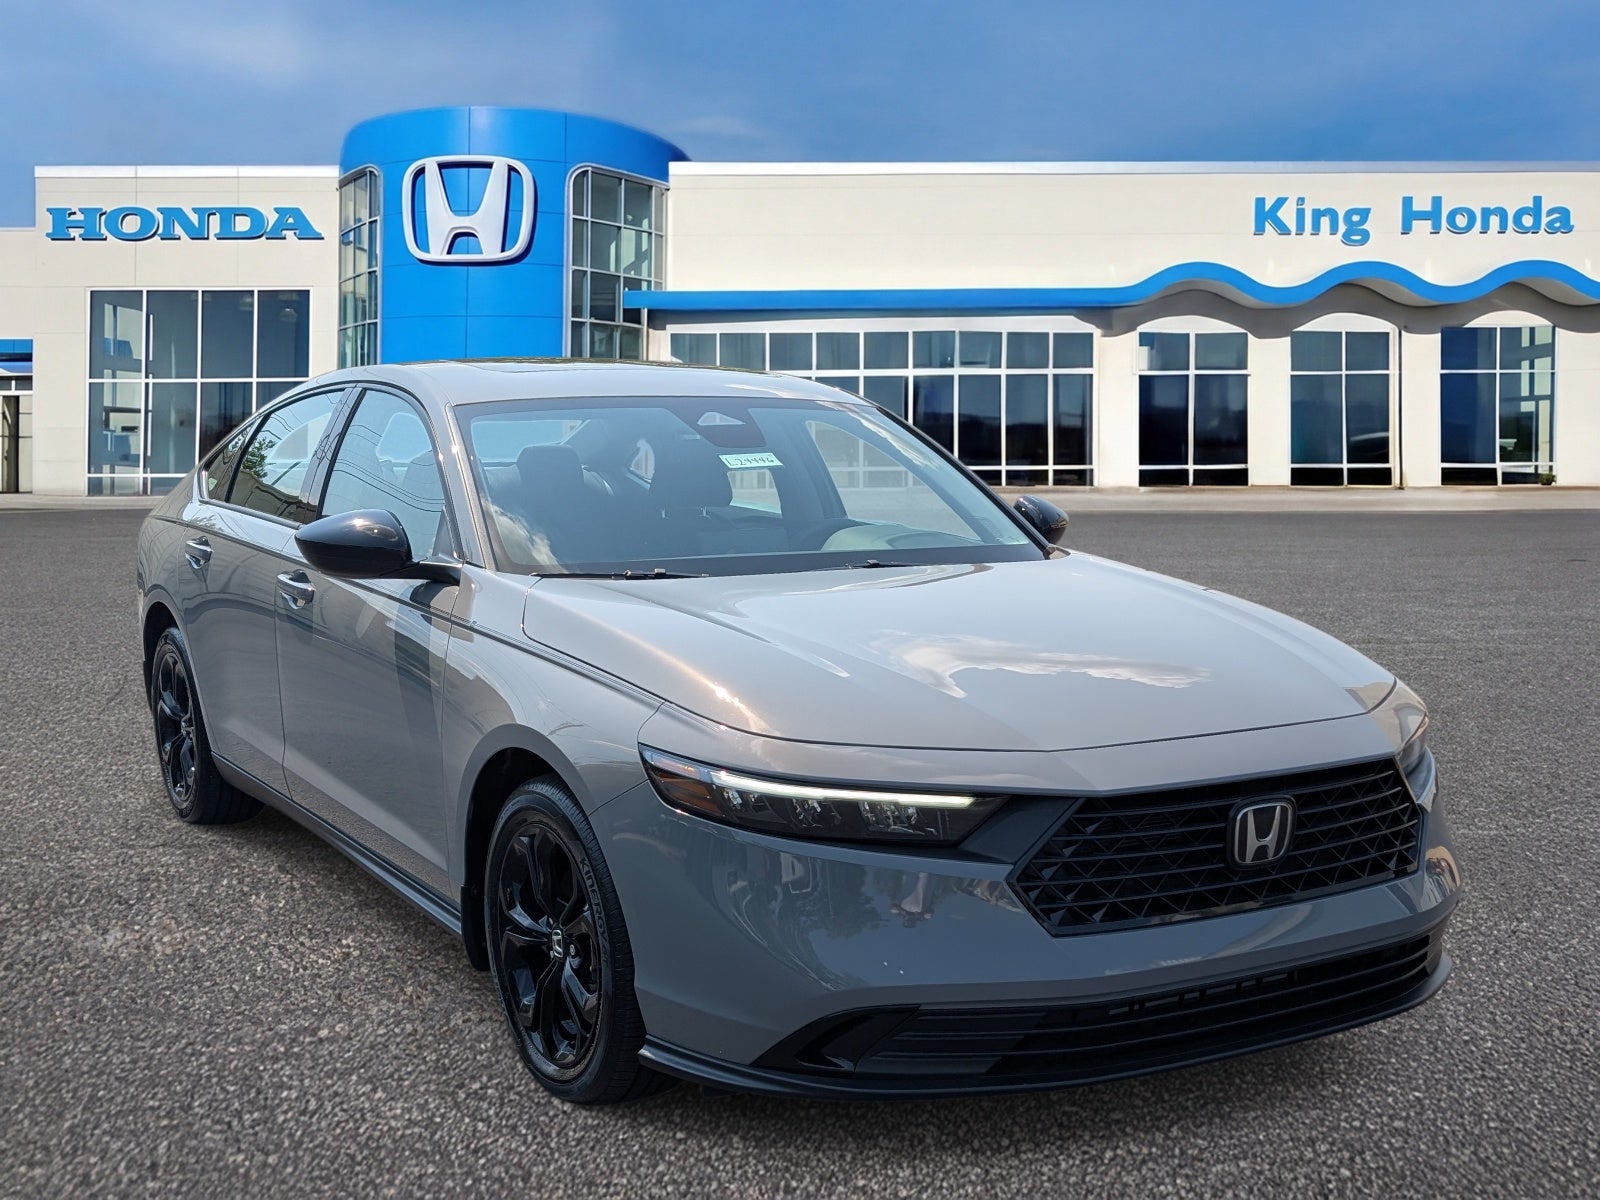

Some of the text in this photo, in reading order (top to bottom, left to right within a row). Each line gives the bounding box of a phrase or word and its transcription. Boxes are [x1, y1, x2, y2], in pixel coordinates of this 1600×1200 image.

[46, 206, 324, 241] HONDA
[1253, 195, 1575, 246] King Honda
